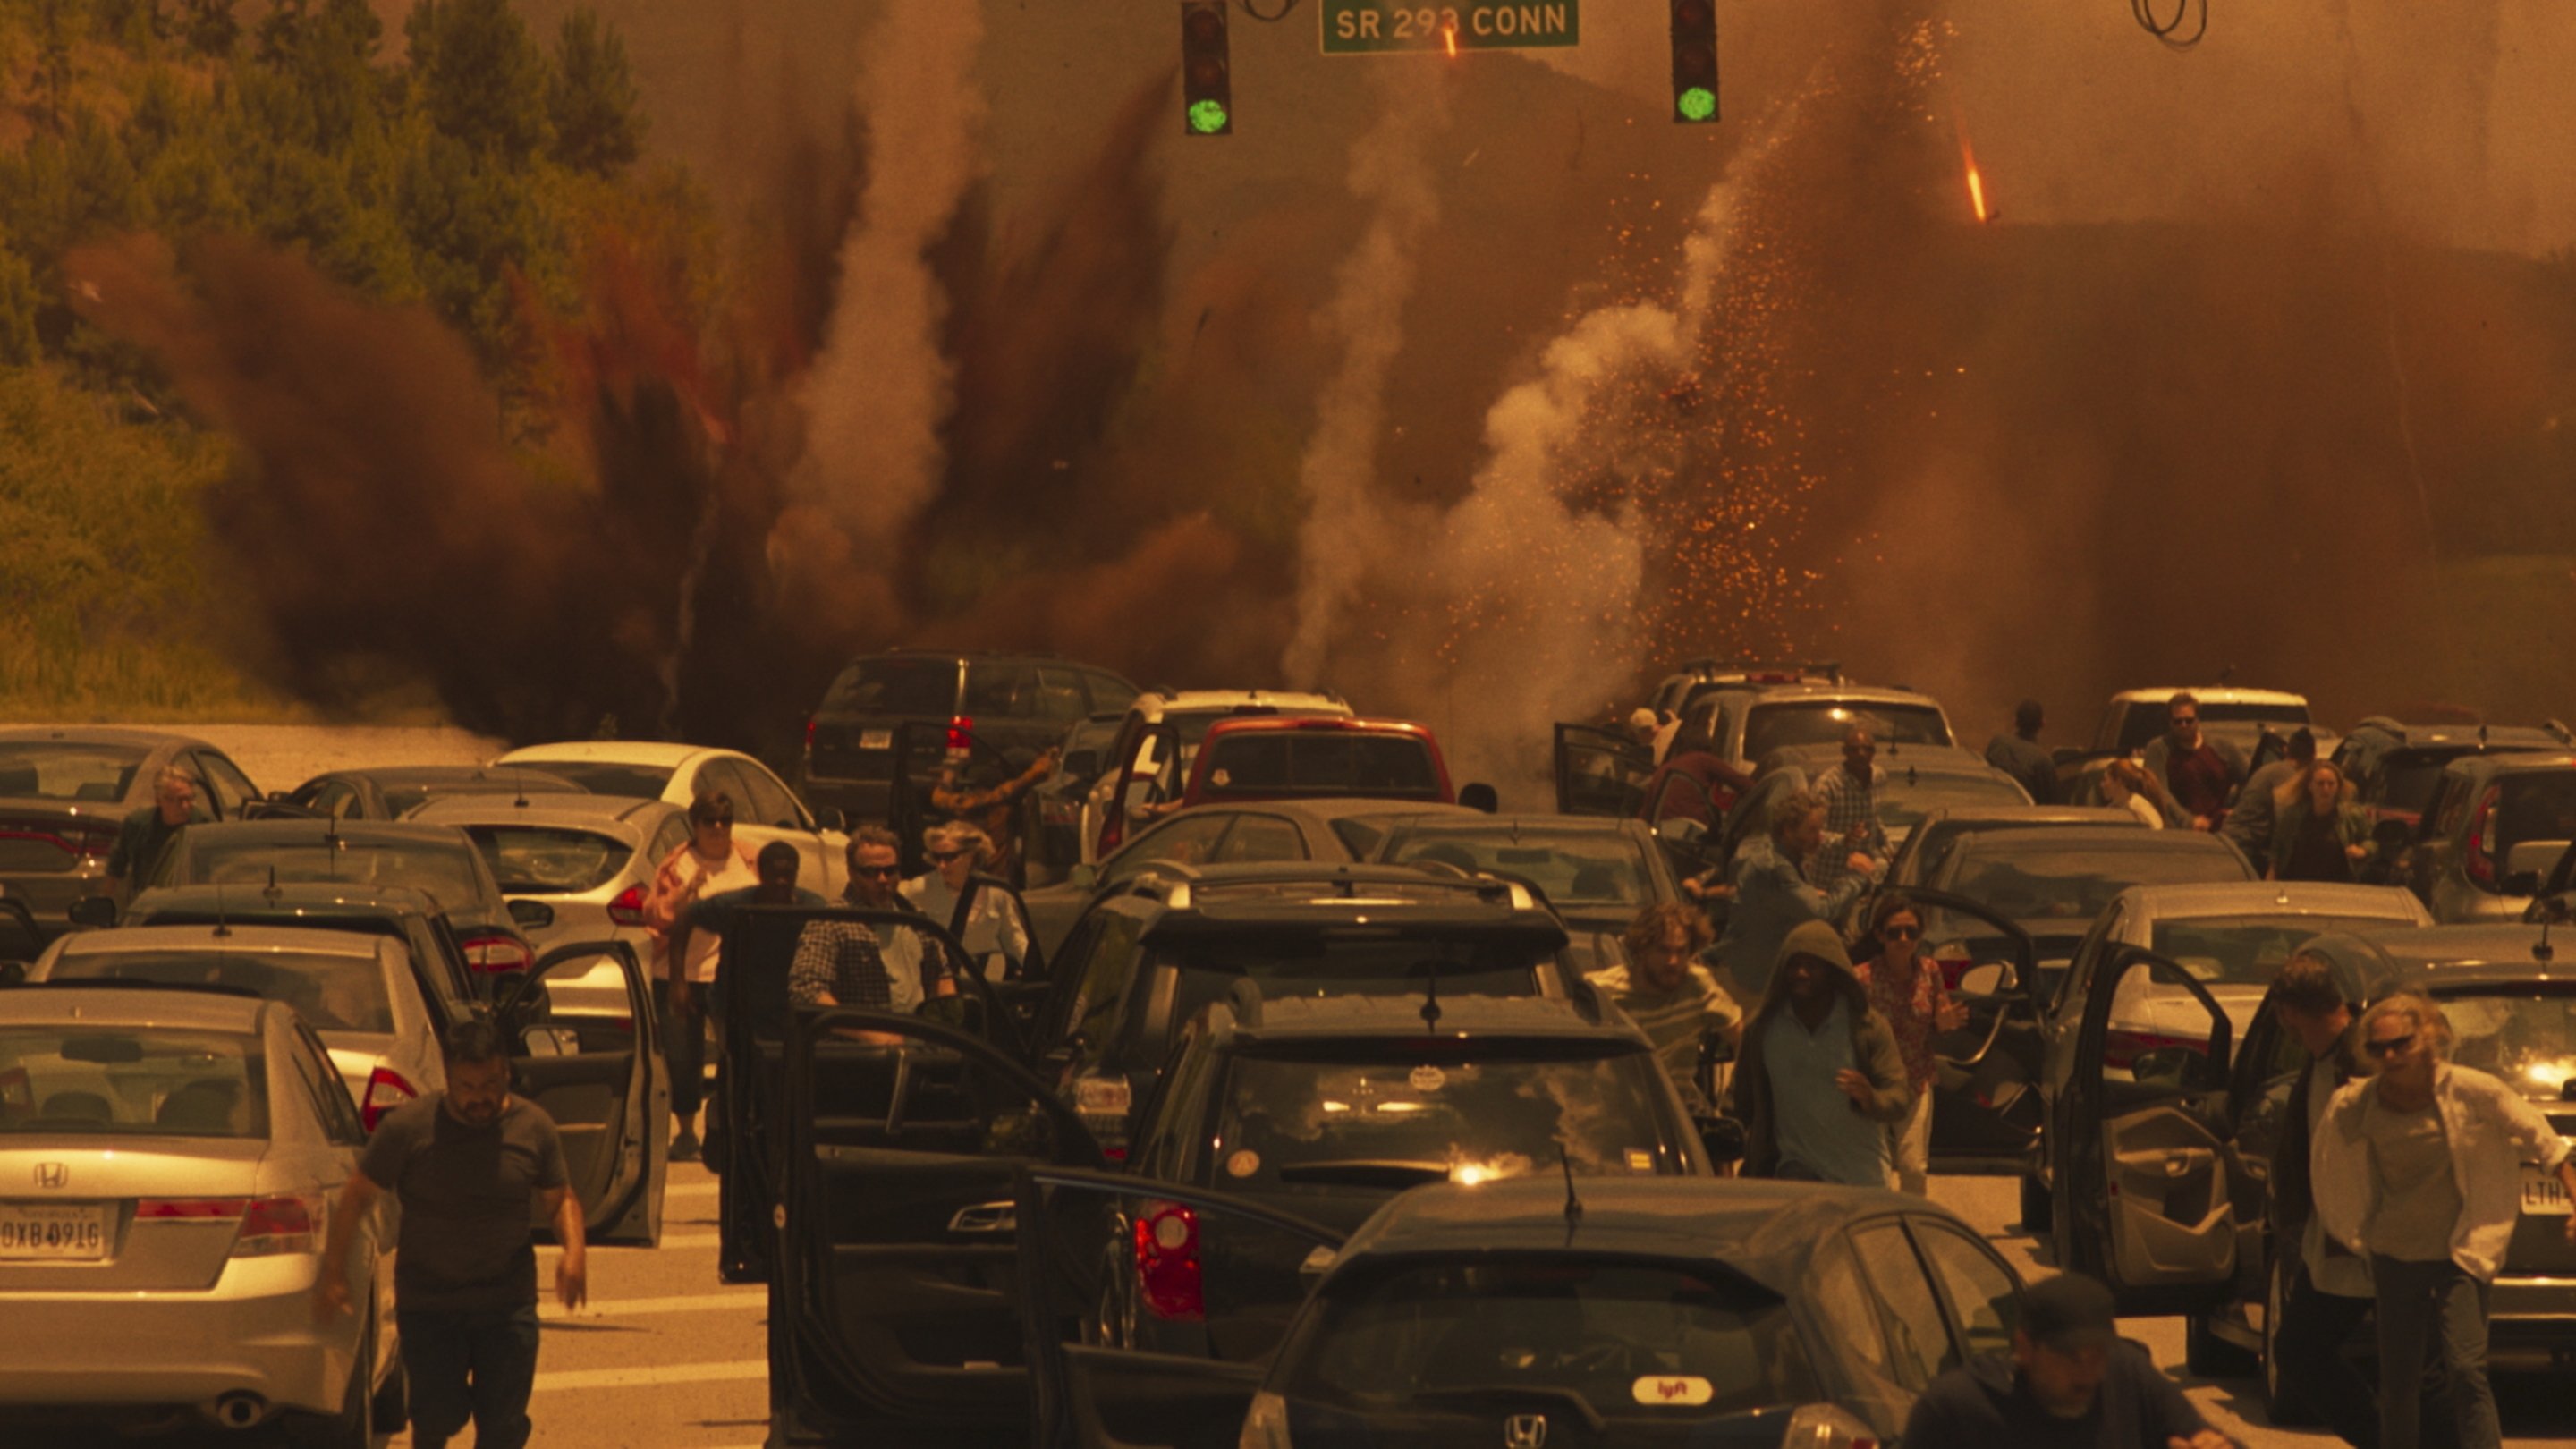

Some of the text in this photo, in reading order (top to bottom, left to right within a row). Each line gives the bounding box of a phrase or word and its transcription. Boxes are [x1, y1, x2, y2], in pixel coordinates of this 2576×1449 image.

[1336, 4, 1566, 38] SR 293 CONN
[1657, 1380, 1688, 1400] lyft
